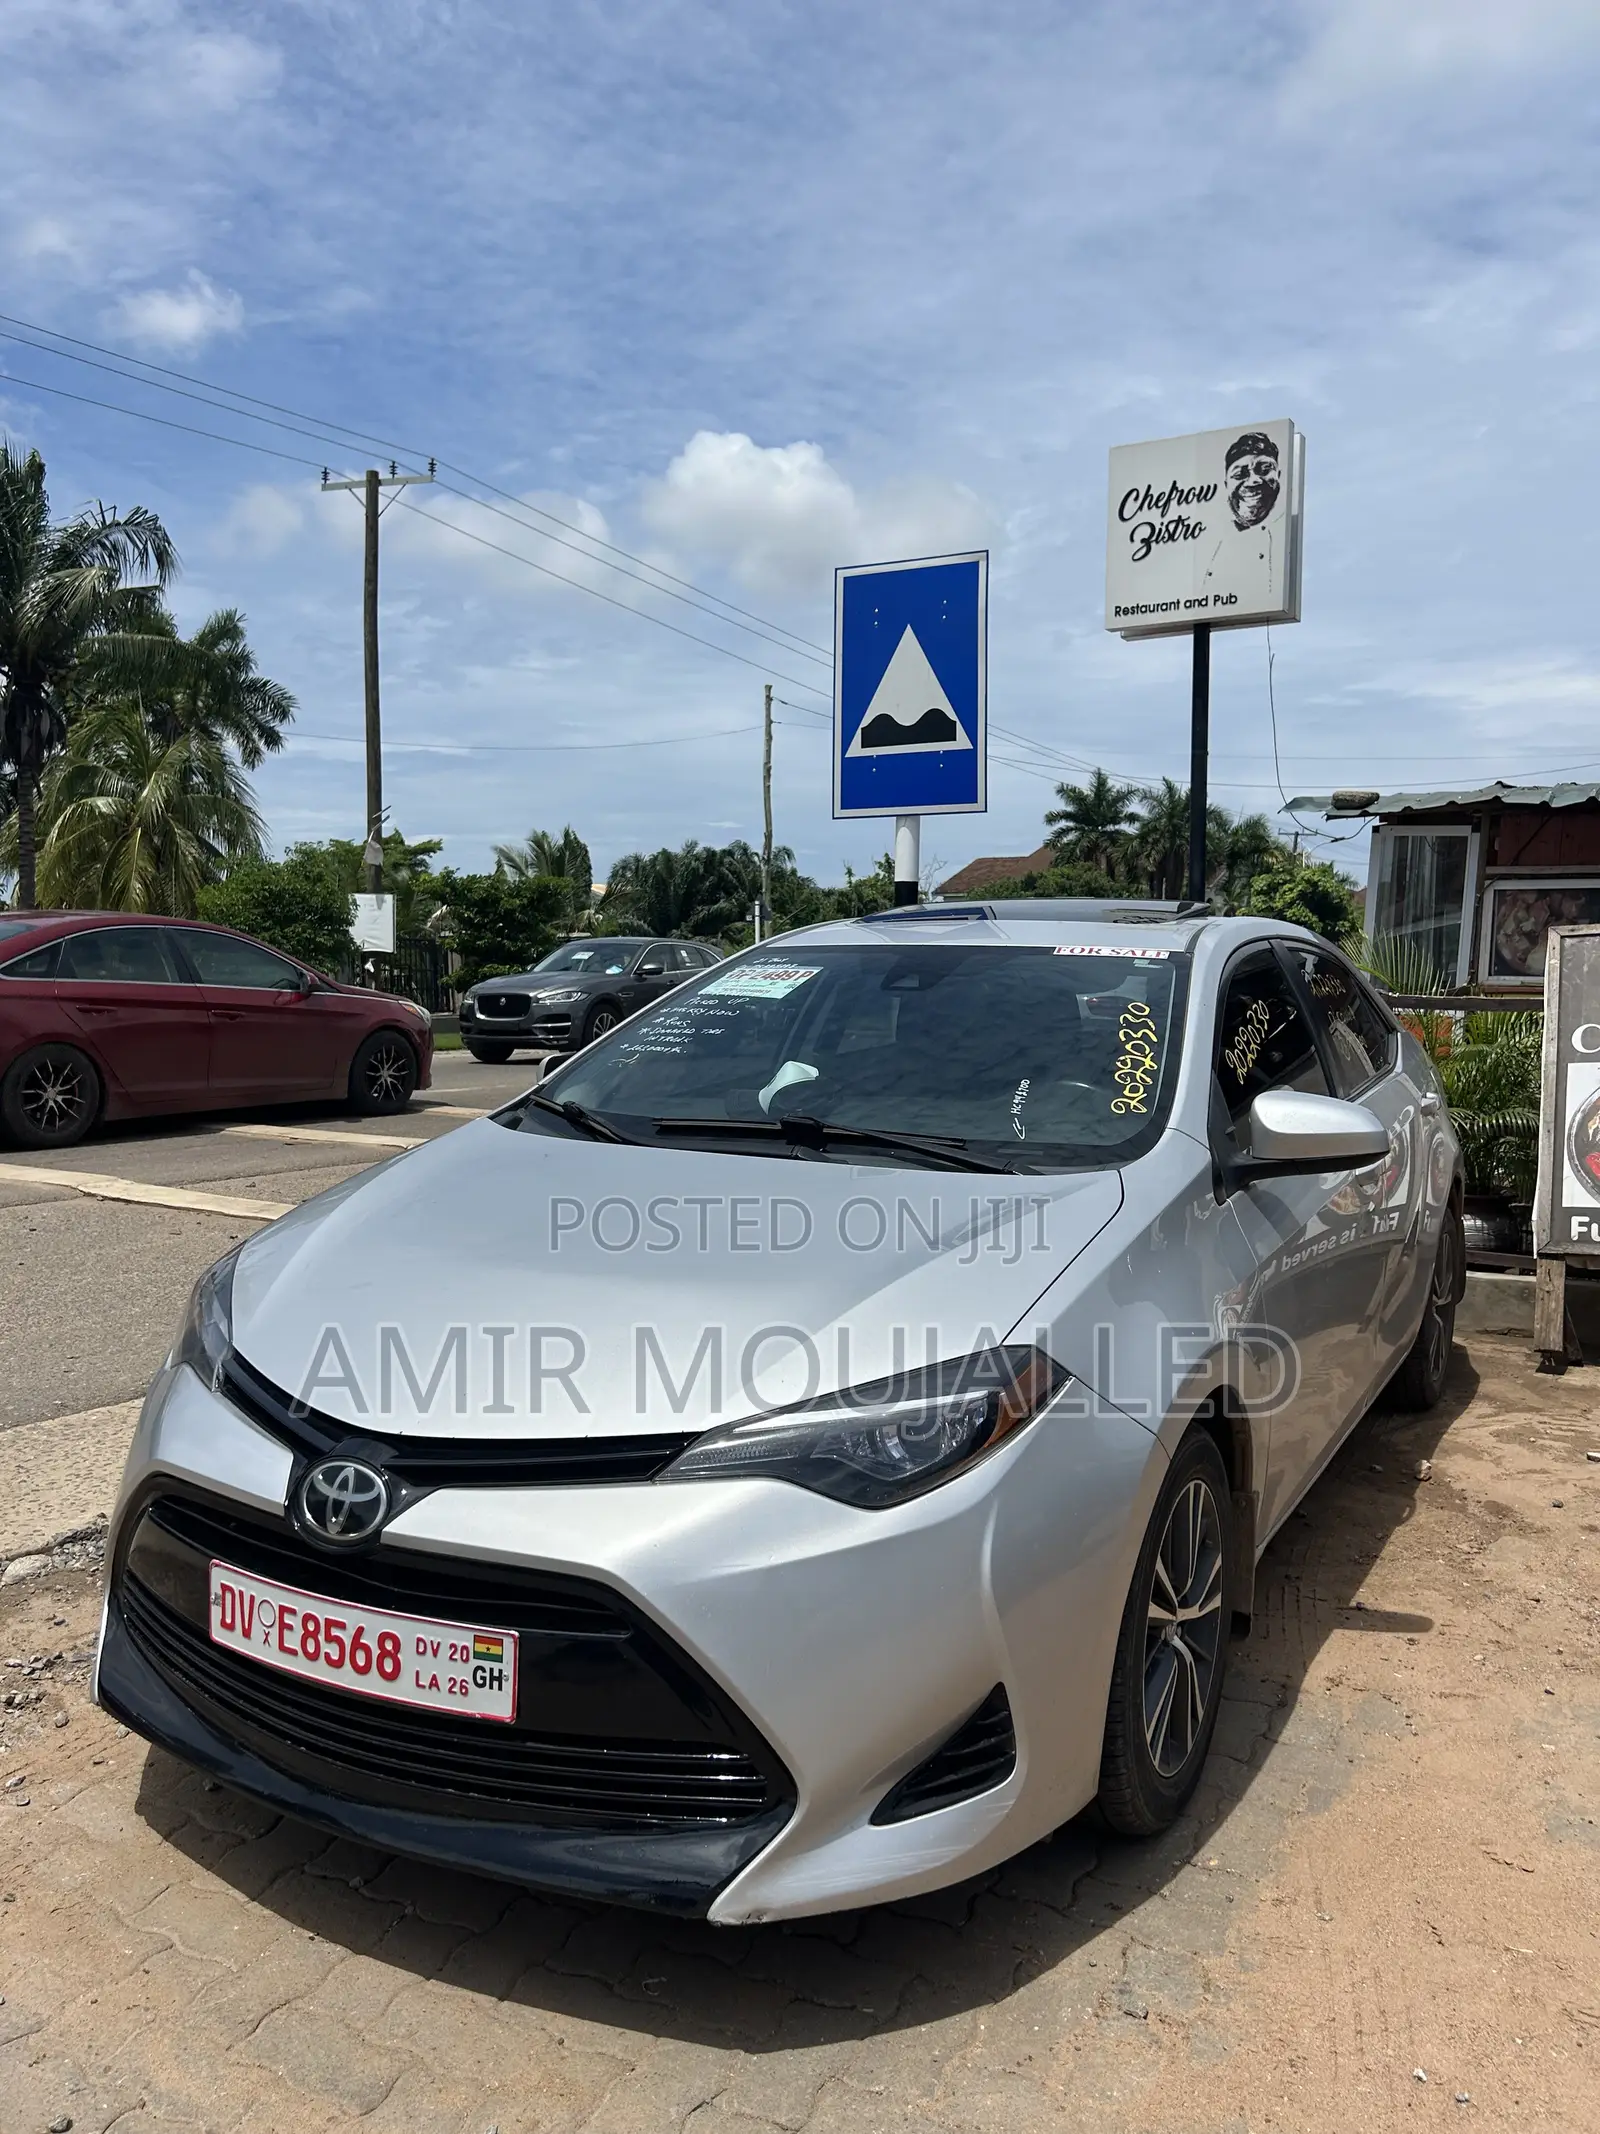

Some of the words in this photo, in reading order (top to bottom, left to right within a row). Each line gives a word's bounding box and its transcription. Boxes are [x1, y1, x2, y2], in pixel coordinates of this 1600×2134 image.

[1118, 479, 1218, 522] Chefrow
[1114, 598, 1180, 618] Restaurant
[1184, 595, 1209, 609] and
[1213, 593, 1238, 605] Pub
[1055, 946, 1103, 955] FOR
[1108, 948, 1168, 958] SALE
[220, 1580, 256, 1641] DV
[277, 1602, 402, 1683] E8568
[415, 1635, 442, 1659] DV
[448, 1642, 471, 1664] 20
[414, 1669, 442, 1693] LA
[447, 1676, 470, 1697] 26
[472, 1664, 503, 1692] GH
